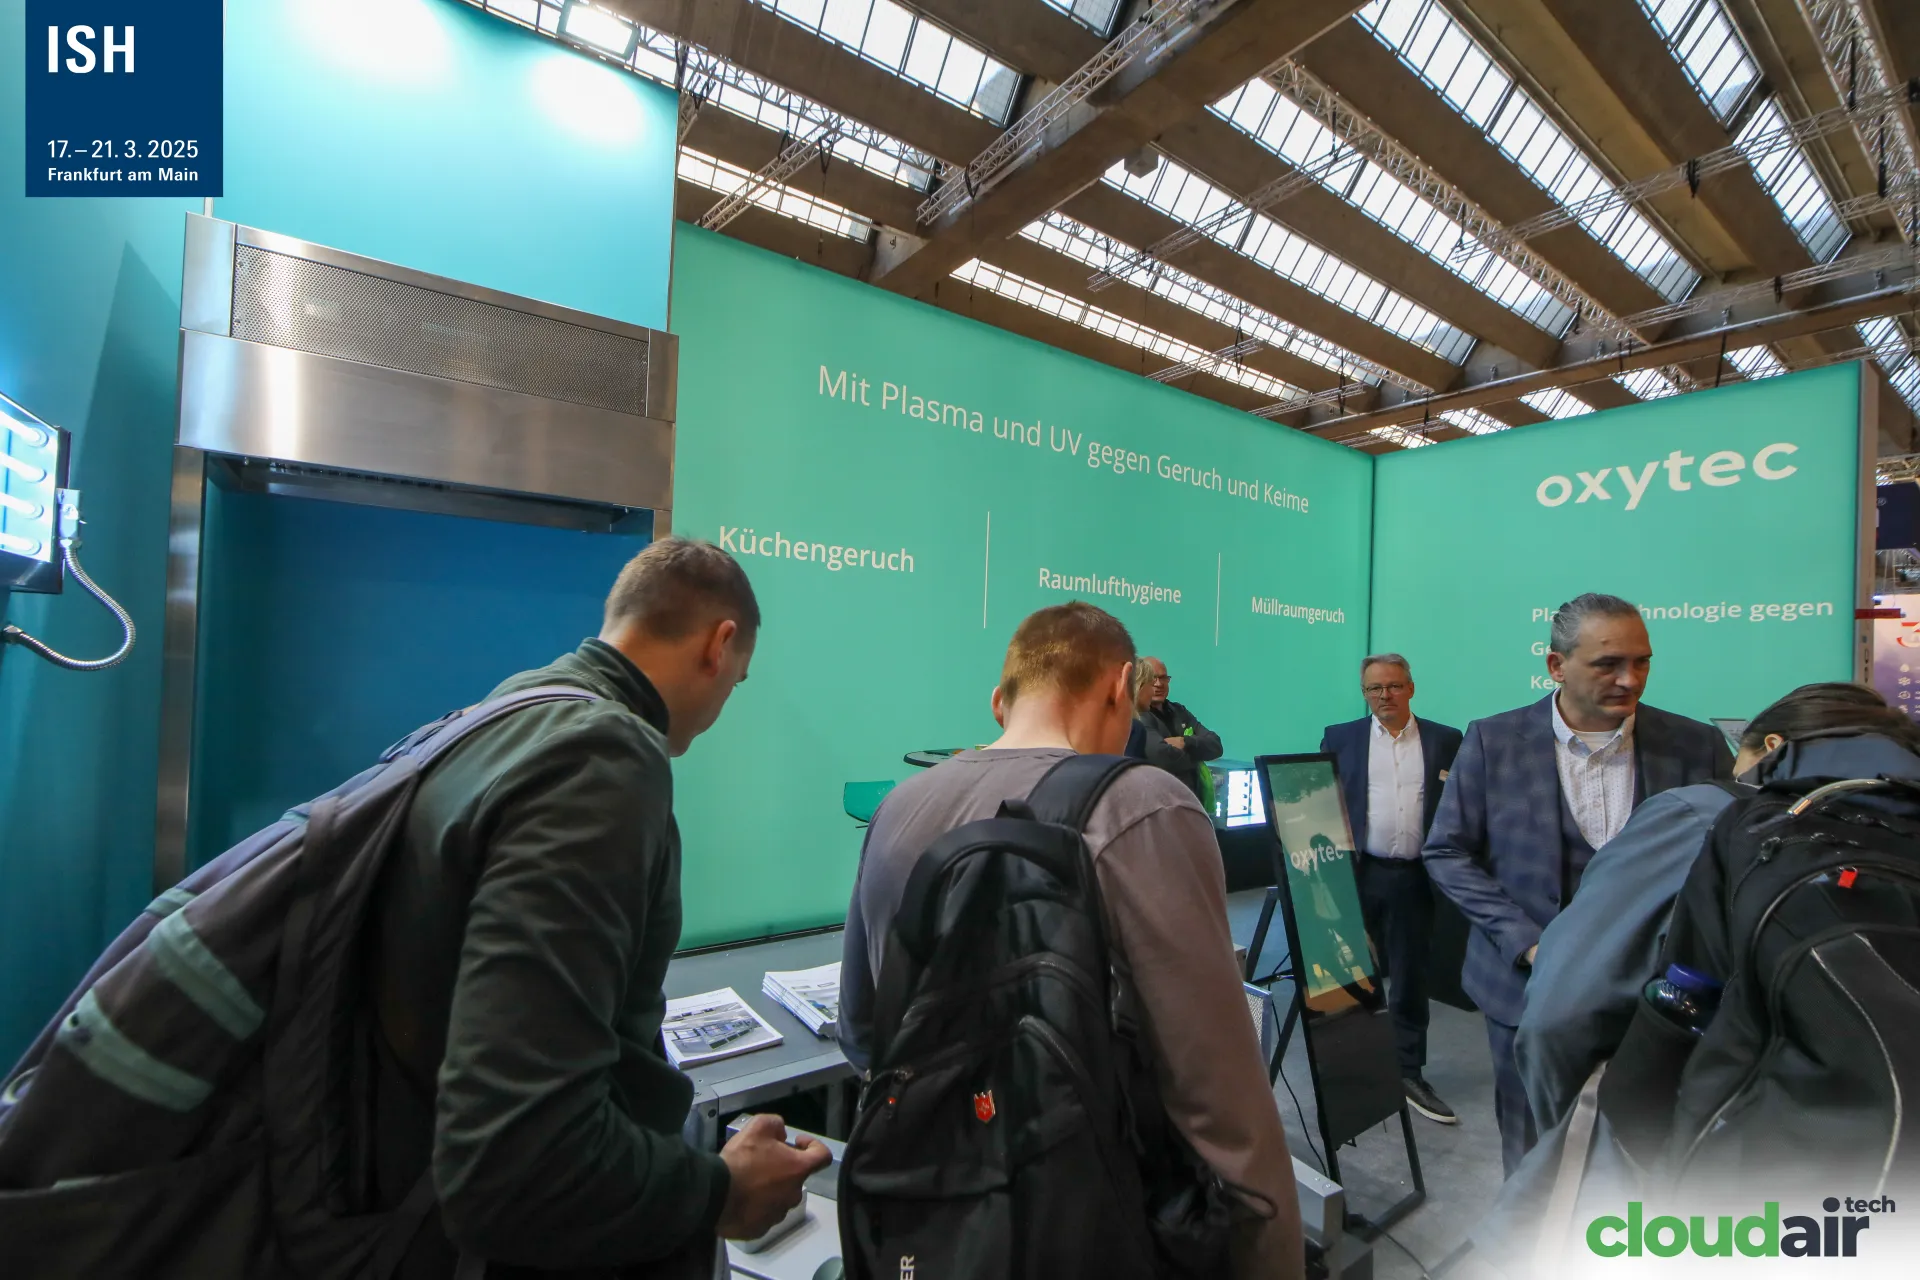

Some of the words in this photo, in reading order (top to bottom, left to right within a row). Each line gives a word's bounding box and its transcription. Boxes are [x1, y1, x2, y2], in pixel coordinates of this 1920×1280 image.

[819, 363, 872, 408] Mit
[882, 381, 984, 434] Plasma
[993, 416, 1042, 447] und
[1050, 425, 1083, 457] UV
[1087, 440, 1151, 475] gegen
[1157, 455, 1222, 493] Geruch
[1227, 477, 1260, 502] und
[1264, 483, 1310, 515] Keime
[1535, 441, 1800, 512] oxytec
[718, 524, 916, 574] Küchengeruch
[1038, 565, 1183, 607] Raumlufthygiene
[1251, 595, 1346, 627] Müllraumgeruch
[1749, 601, 1834, 623] gegen
[1290, 843, 1344, 872] oxytec
